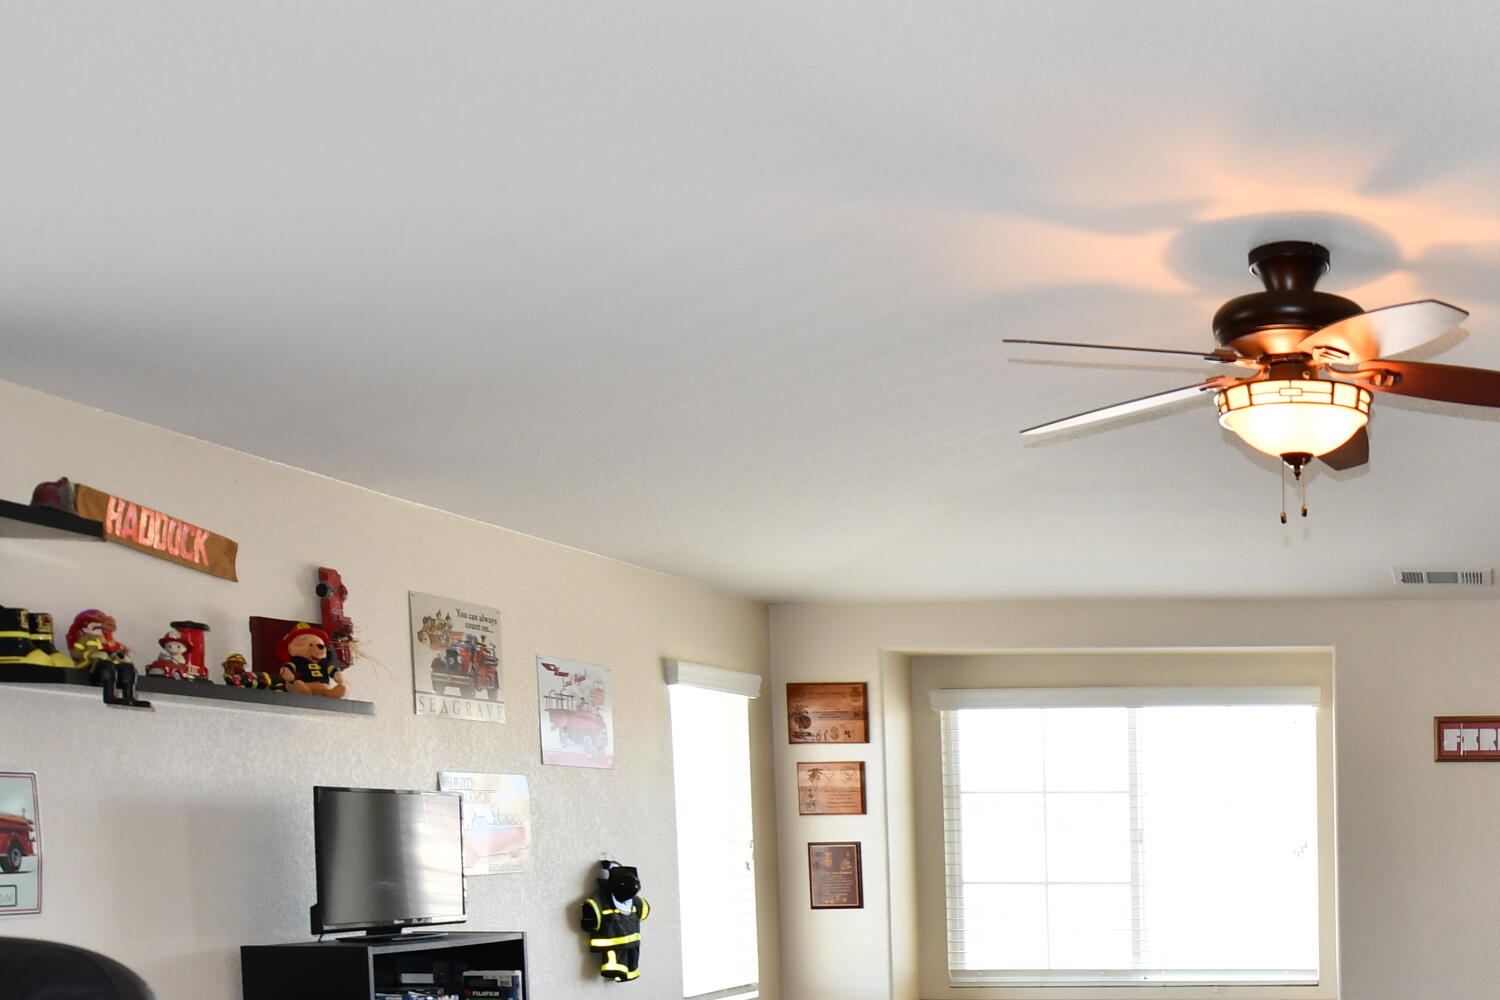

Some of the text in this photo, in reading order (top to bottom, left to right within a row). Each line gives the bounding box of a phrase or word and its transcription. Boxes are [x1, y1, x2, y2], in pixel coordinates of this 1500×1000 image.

[105, 495, 209, 566] HADDOCK
[456, 608, 467, 619] You
[479, 612, 498, 626] always
[417, 695, 505, 722] SEAGRAVE
